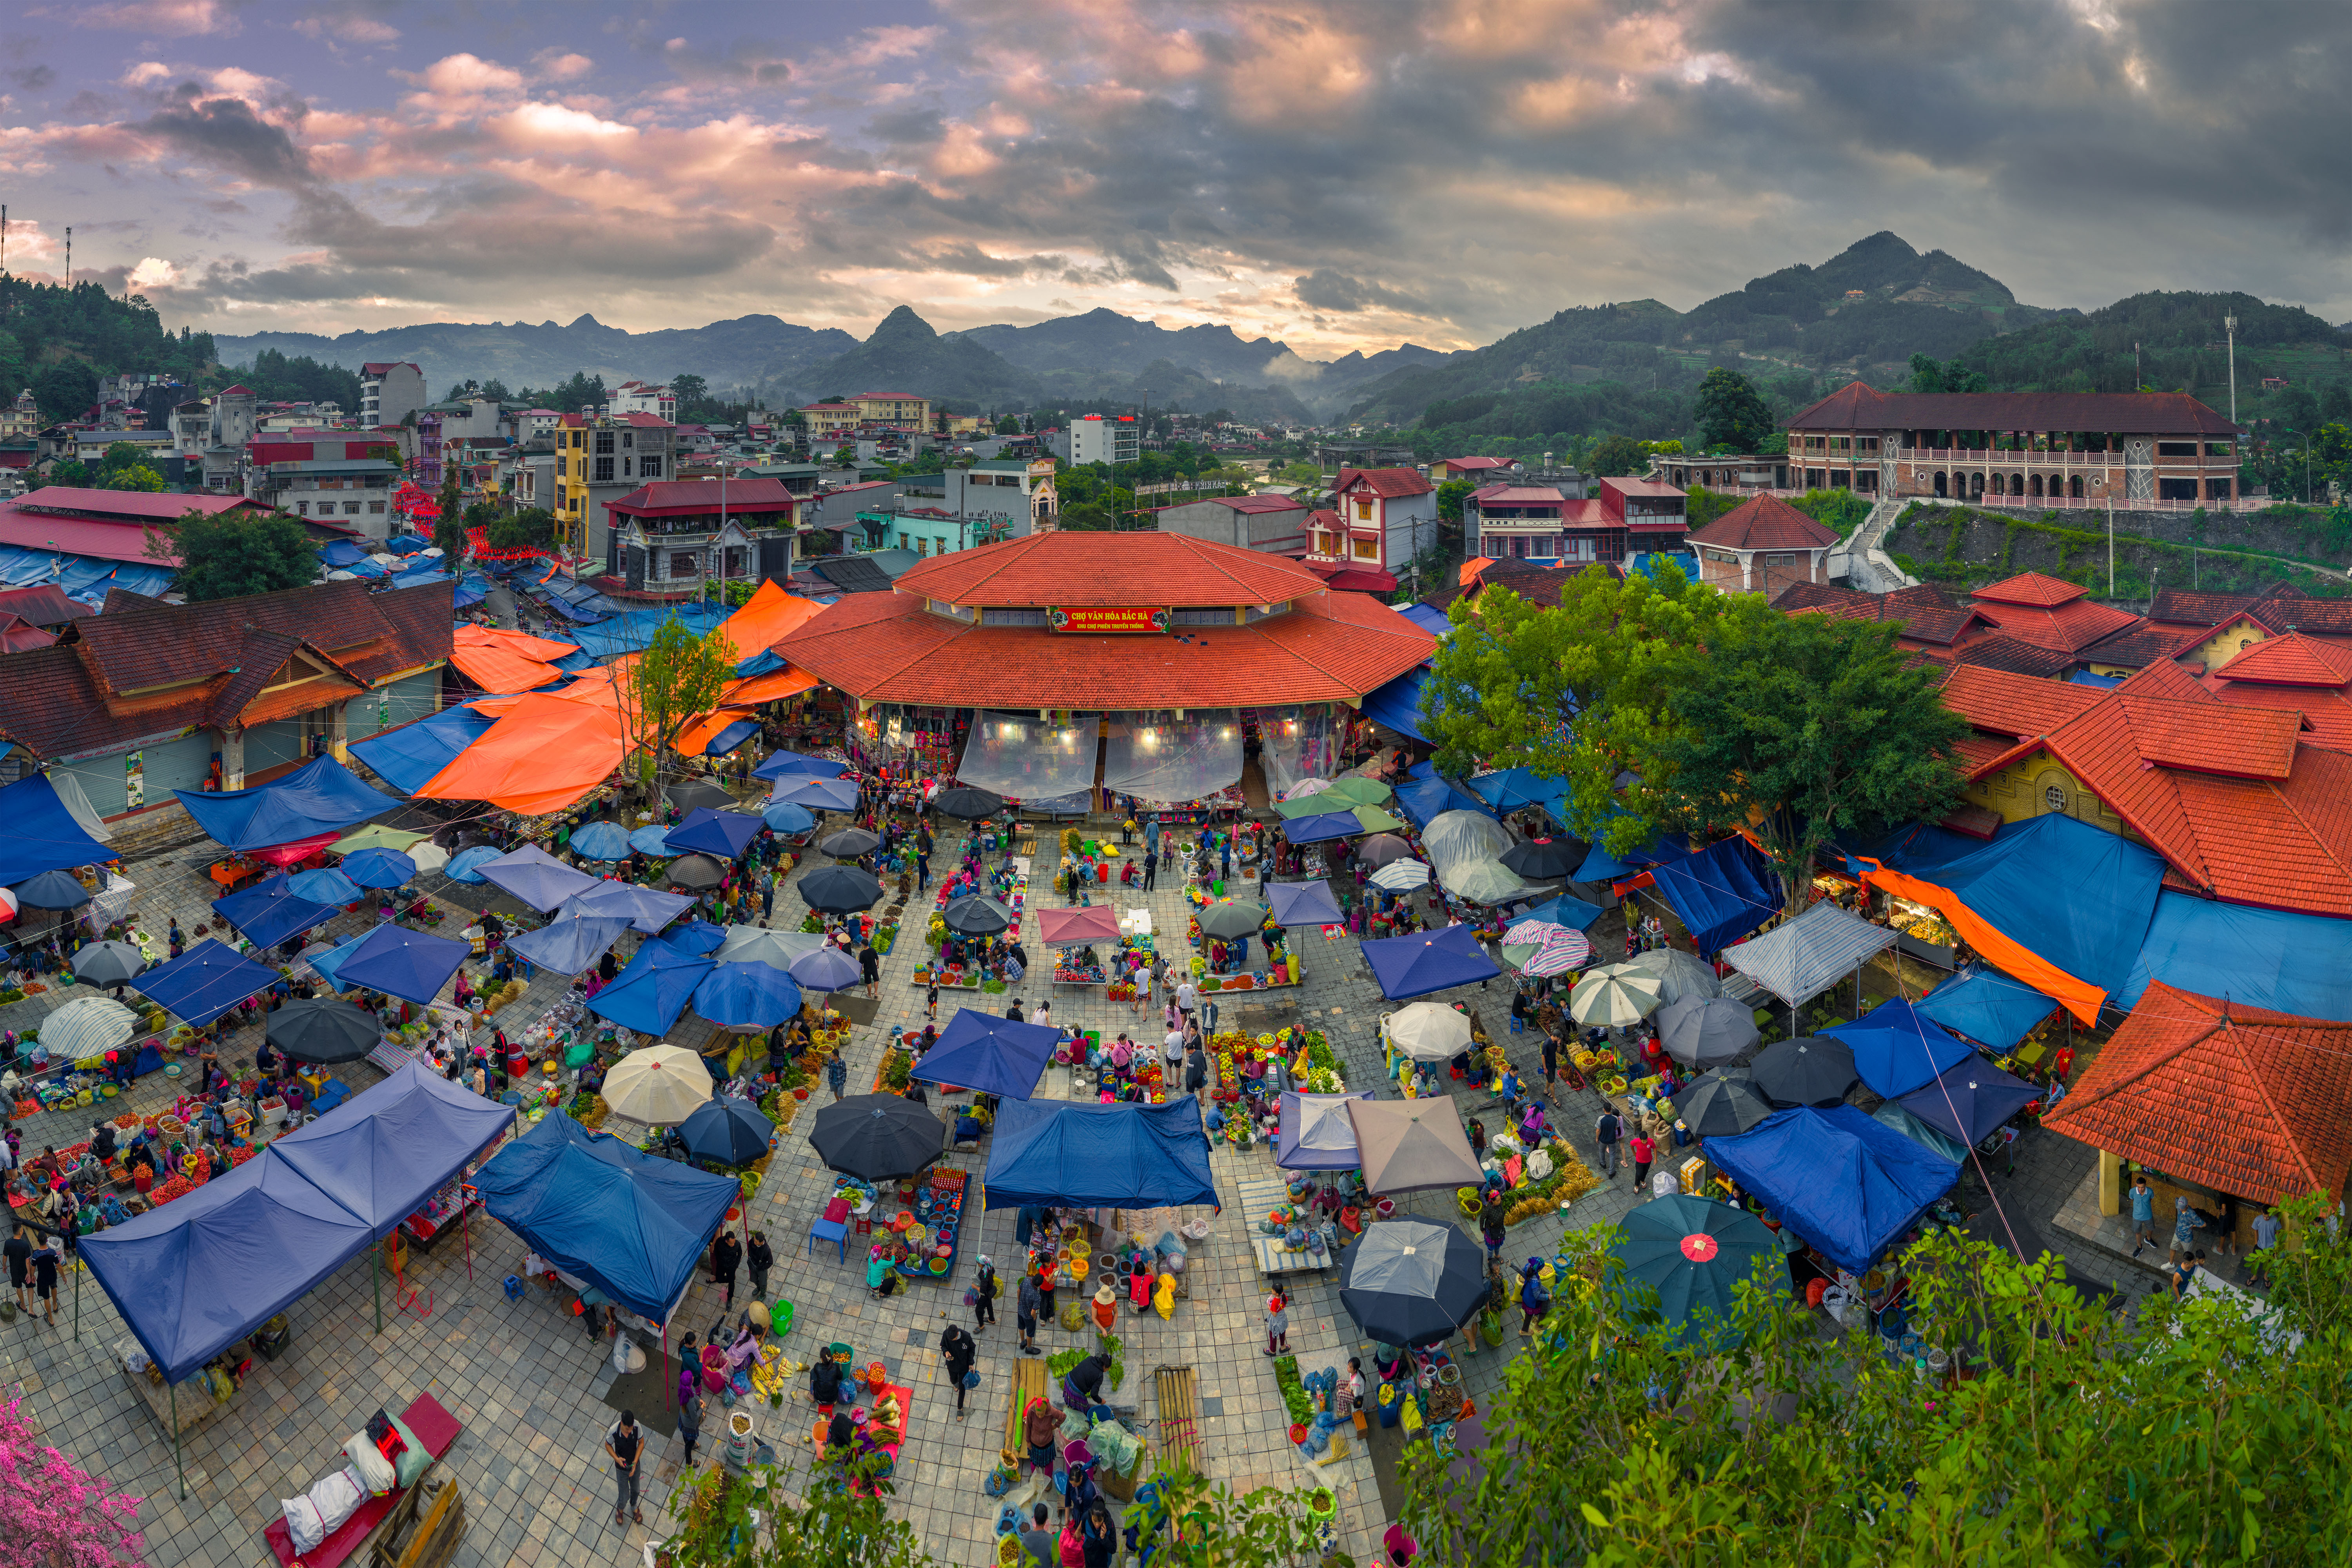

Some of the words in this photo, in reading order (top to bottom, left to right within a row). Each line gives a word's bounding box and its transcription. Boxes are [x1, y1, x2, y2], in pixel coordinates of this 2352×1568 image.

[1071, 612, 1086, 622] CHỢ
[1087, 611, 1103, 620] VĂN
[1105, 611, 1120, 620] HÓA
[1122, 609, 1136, 620] BẮC
[1138, 611, 1148, 620] HÀ
